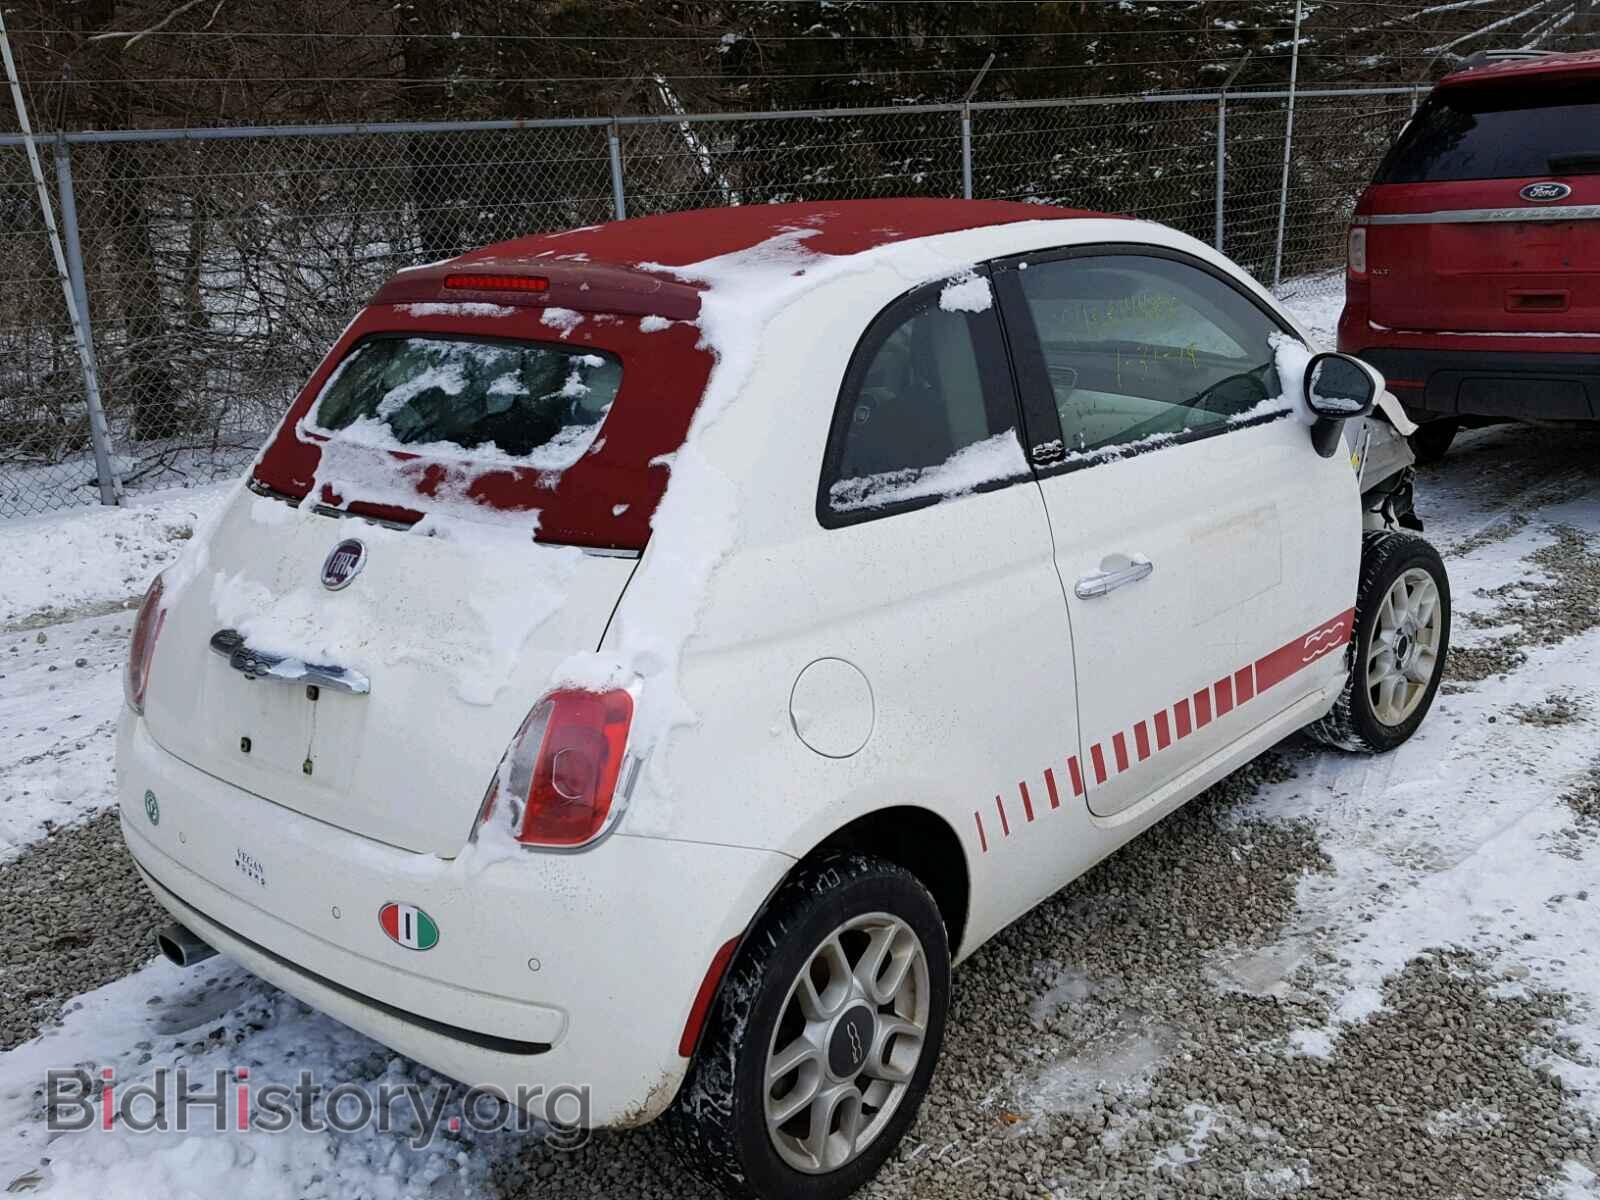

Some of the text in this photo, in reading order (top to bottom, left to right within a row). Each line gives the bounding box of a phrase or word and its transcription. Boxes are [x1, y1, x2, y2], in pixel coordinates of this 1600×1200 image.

[1530, 185, 1559, 197] Ford
[328, 552, 358, 576] FIAT
[1302, 622, 1344, 662] 500
[236, 848, 263, 873] VEGAN
